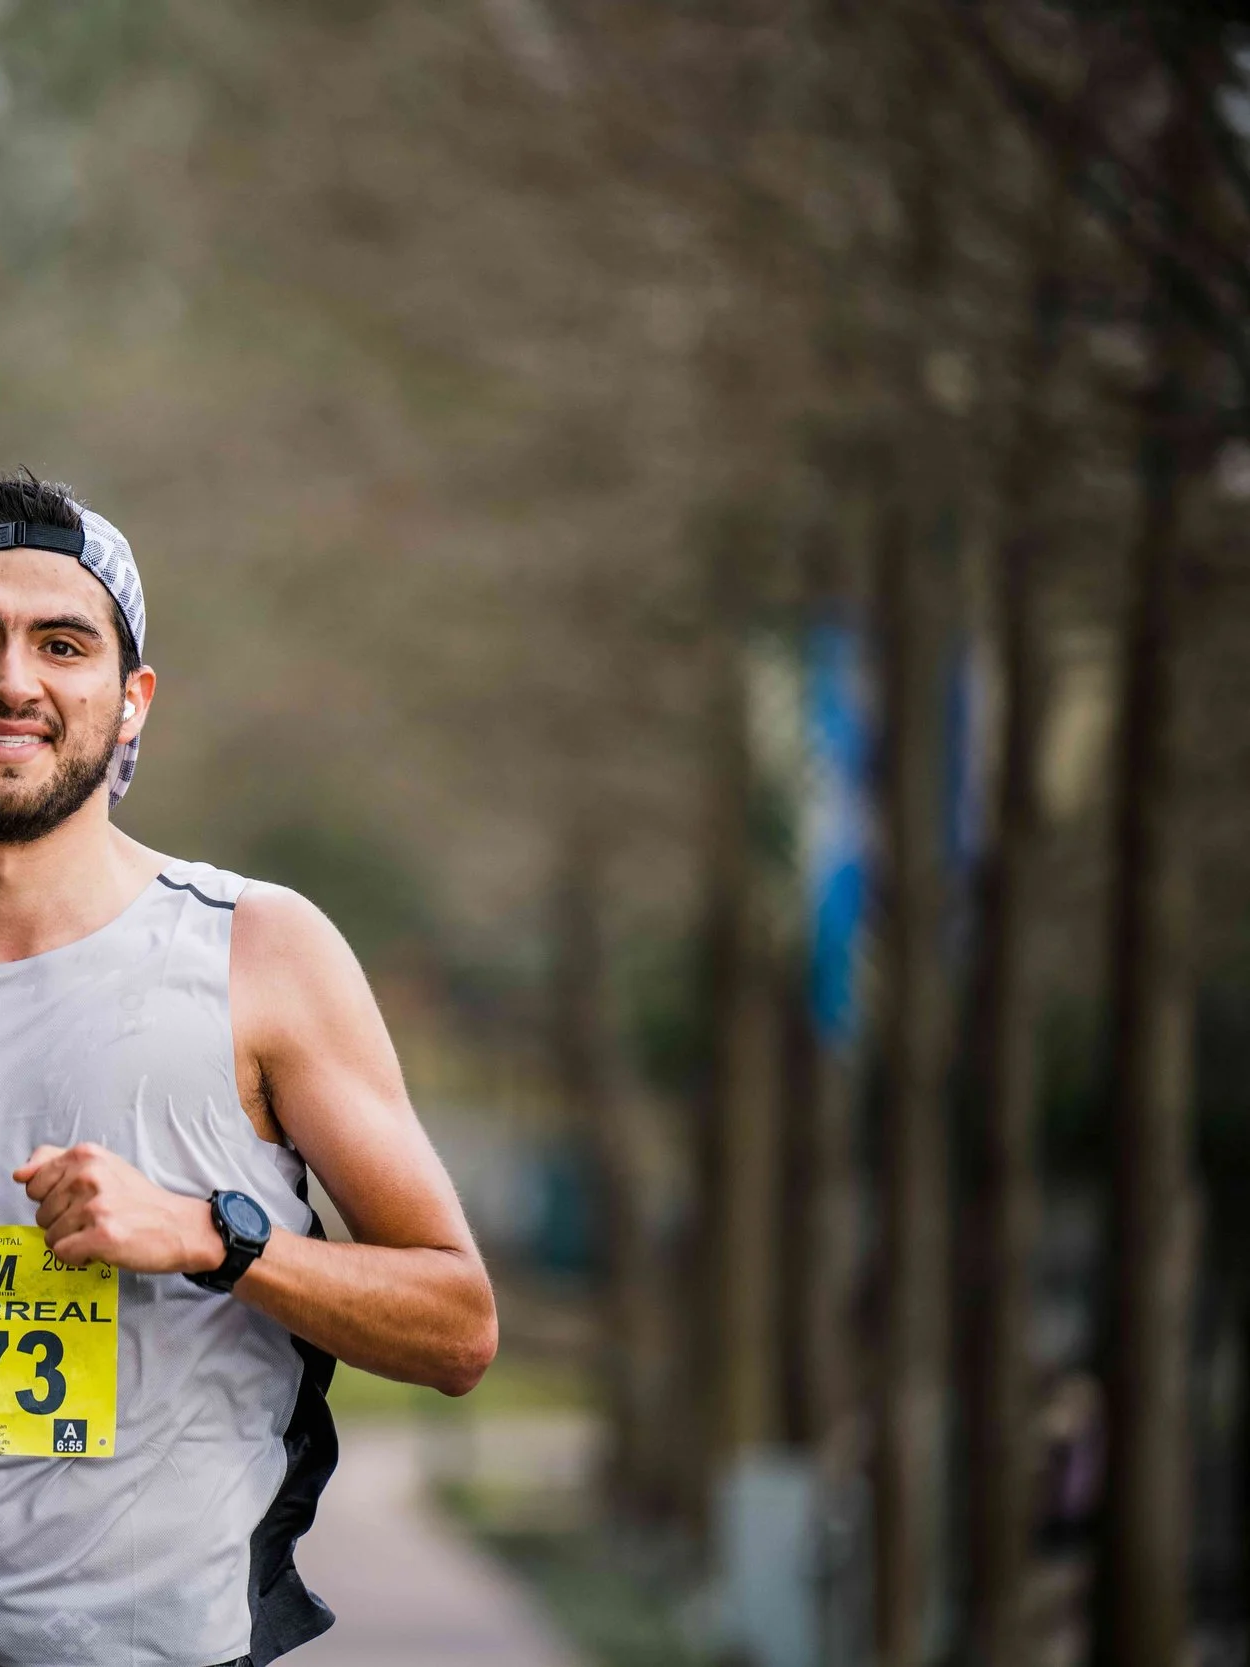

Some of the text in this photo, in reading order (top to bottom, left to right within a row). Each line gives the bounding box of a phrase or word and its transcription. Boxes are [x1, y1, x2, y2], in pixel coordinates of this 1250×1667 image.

[42, 1249, 88, 1272] 20
[63, 1423, 78, 1439] A
[56, 1440, 84, 1452] 6:55
